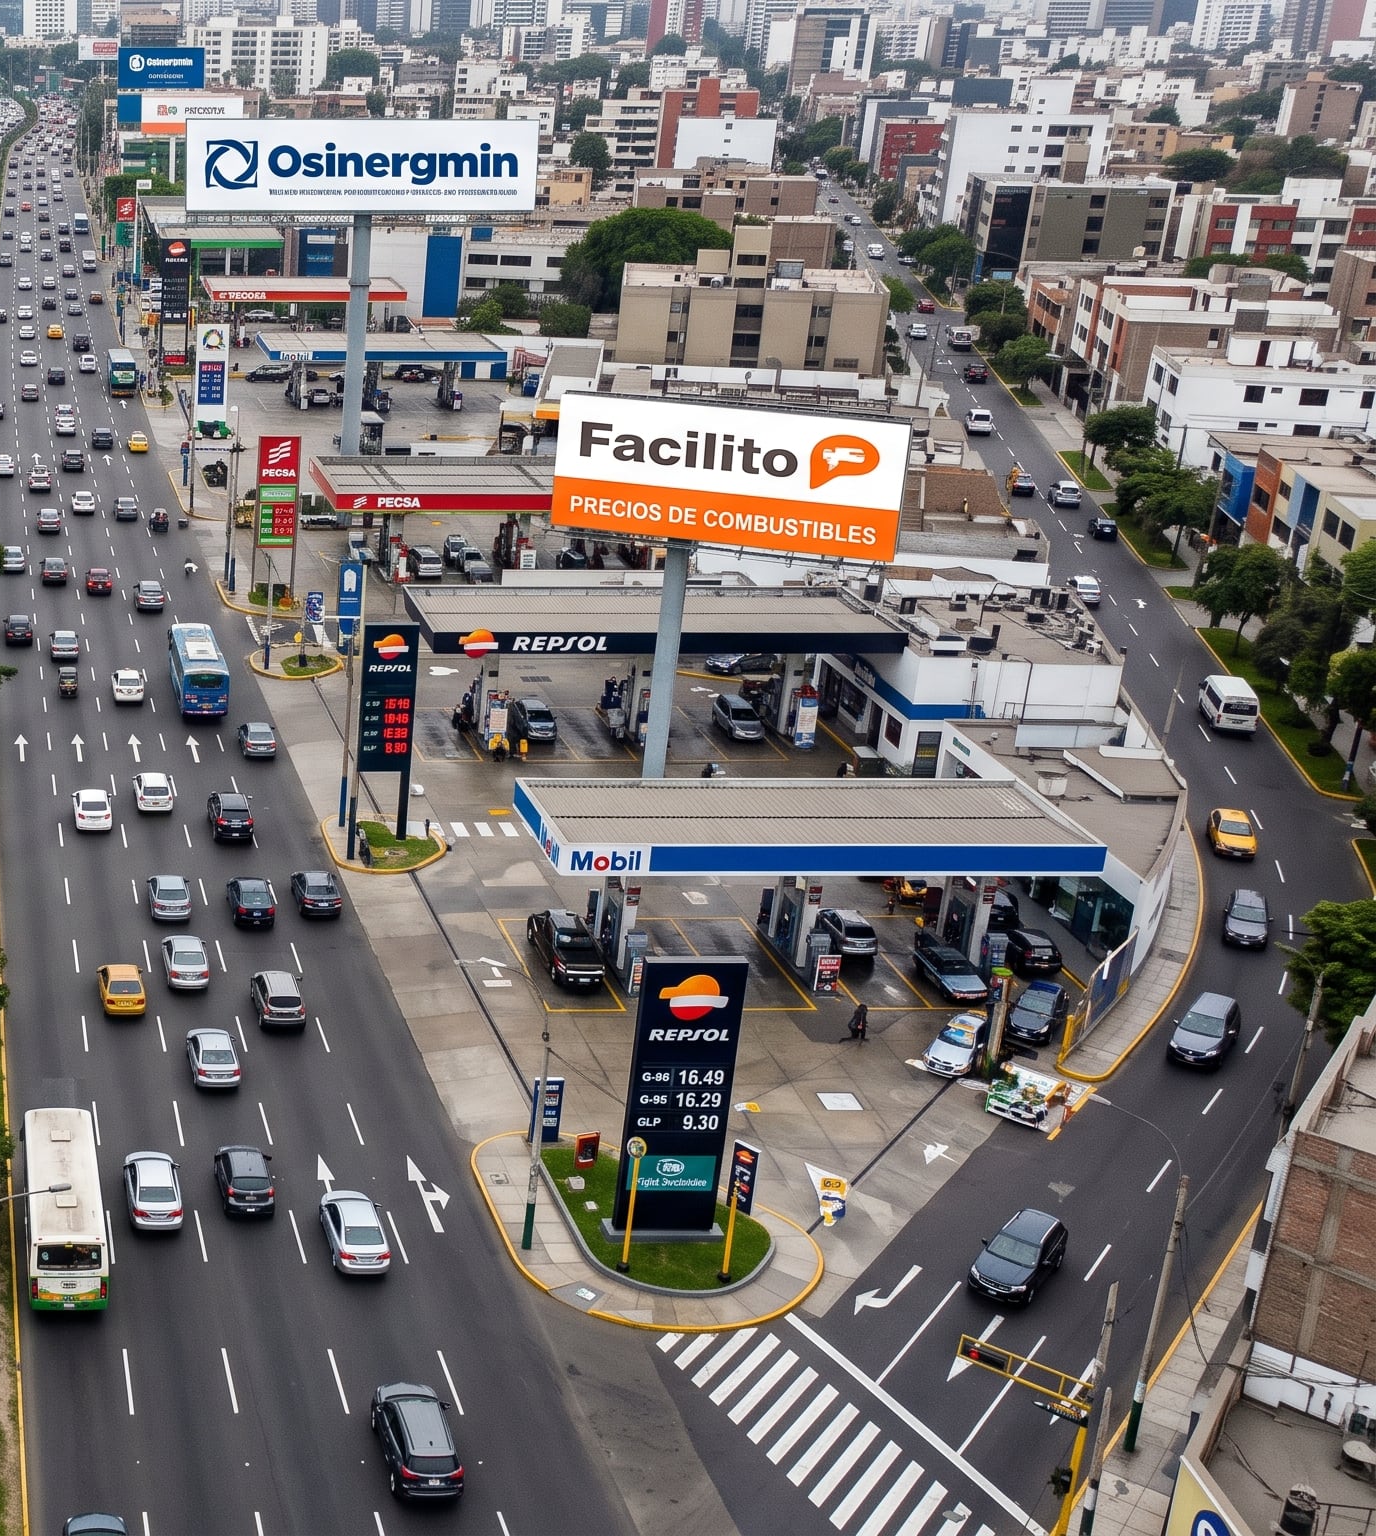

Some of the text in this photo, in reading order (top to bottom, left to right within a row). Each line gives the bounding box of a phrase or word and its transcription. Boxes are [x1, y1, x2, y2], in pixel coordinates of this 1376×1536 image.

[268, 142, 518, 186] Osinergmin
[579, 421, 799, 477] Facilito
[262, 468, 296, 478] PECSA
[377, 496, 421, 508] PECSA
[569, 495, 877, 545] PRECIOS DE COMBUSTIBLES
[512, 636, 608, 652] REPSOL
[368, 664, 412, 673] REPSOL
[570, 850, 642, 871] Mobil
[648, 1029, 730, 1042] REPSOL
[678, 1070, 724, 1085] 16.49
[675, 1092, 722, 1108] 16.29
[637, 1114, 719, 1130] GLP 9.30
